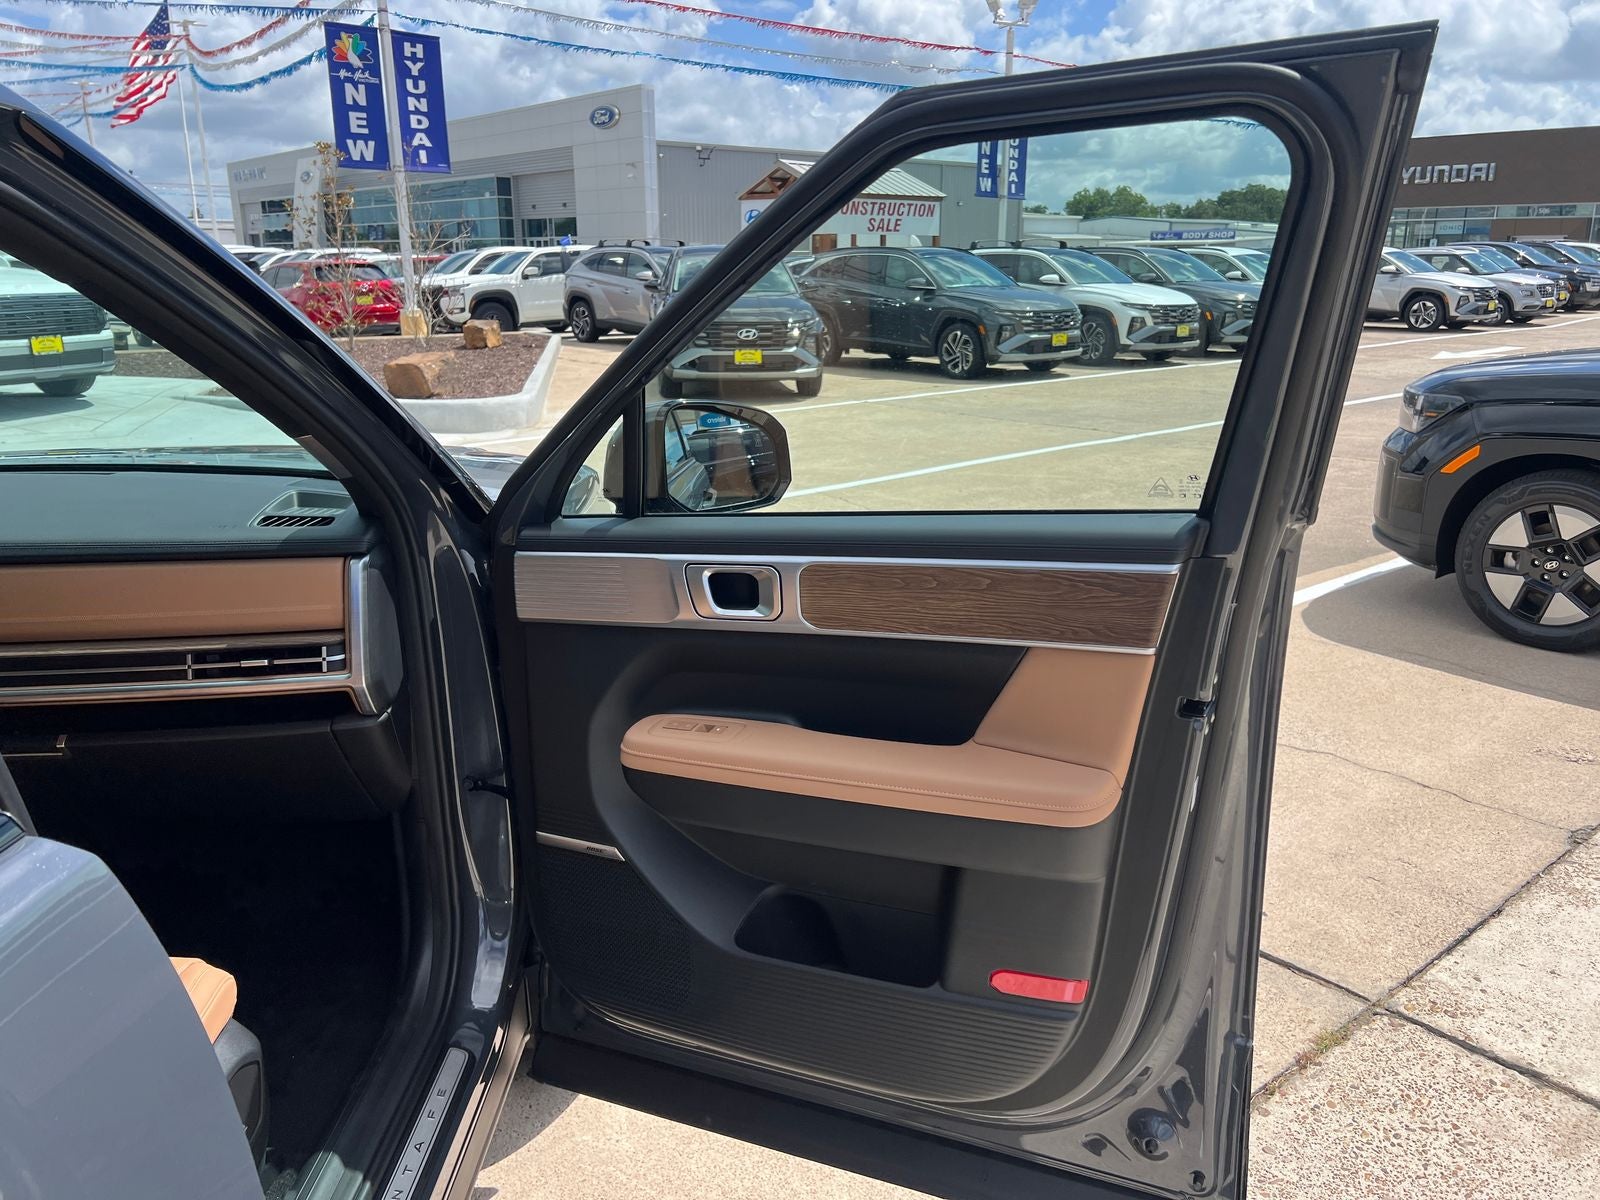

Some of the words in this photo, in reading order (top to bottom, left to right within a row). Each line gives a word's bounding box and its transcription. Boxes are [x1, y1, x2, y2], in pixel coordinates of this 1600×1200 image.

[345, 83, 375, 162] NEW
[403, 42, 433, 164] HYUNDAI
[979, 141, 992, 192] NEW
[1009, 138, 1019, 193] UNDAI
[1402, 162, 1496, 184] YUNDAI
[841, 201, 936, 217] ONSTRUCTION
[867, 218, 902, 232] SALE
[1182, 231, 1207, 239] BODY
[1208, 231, 1235, 239] SHOP
[1464, 514, 1491, 575] NEXEN
[391, 1141, 425, 1200] NTA
[428, 1088, 448, 1119] FE
